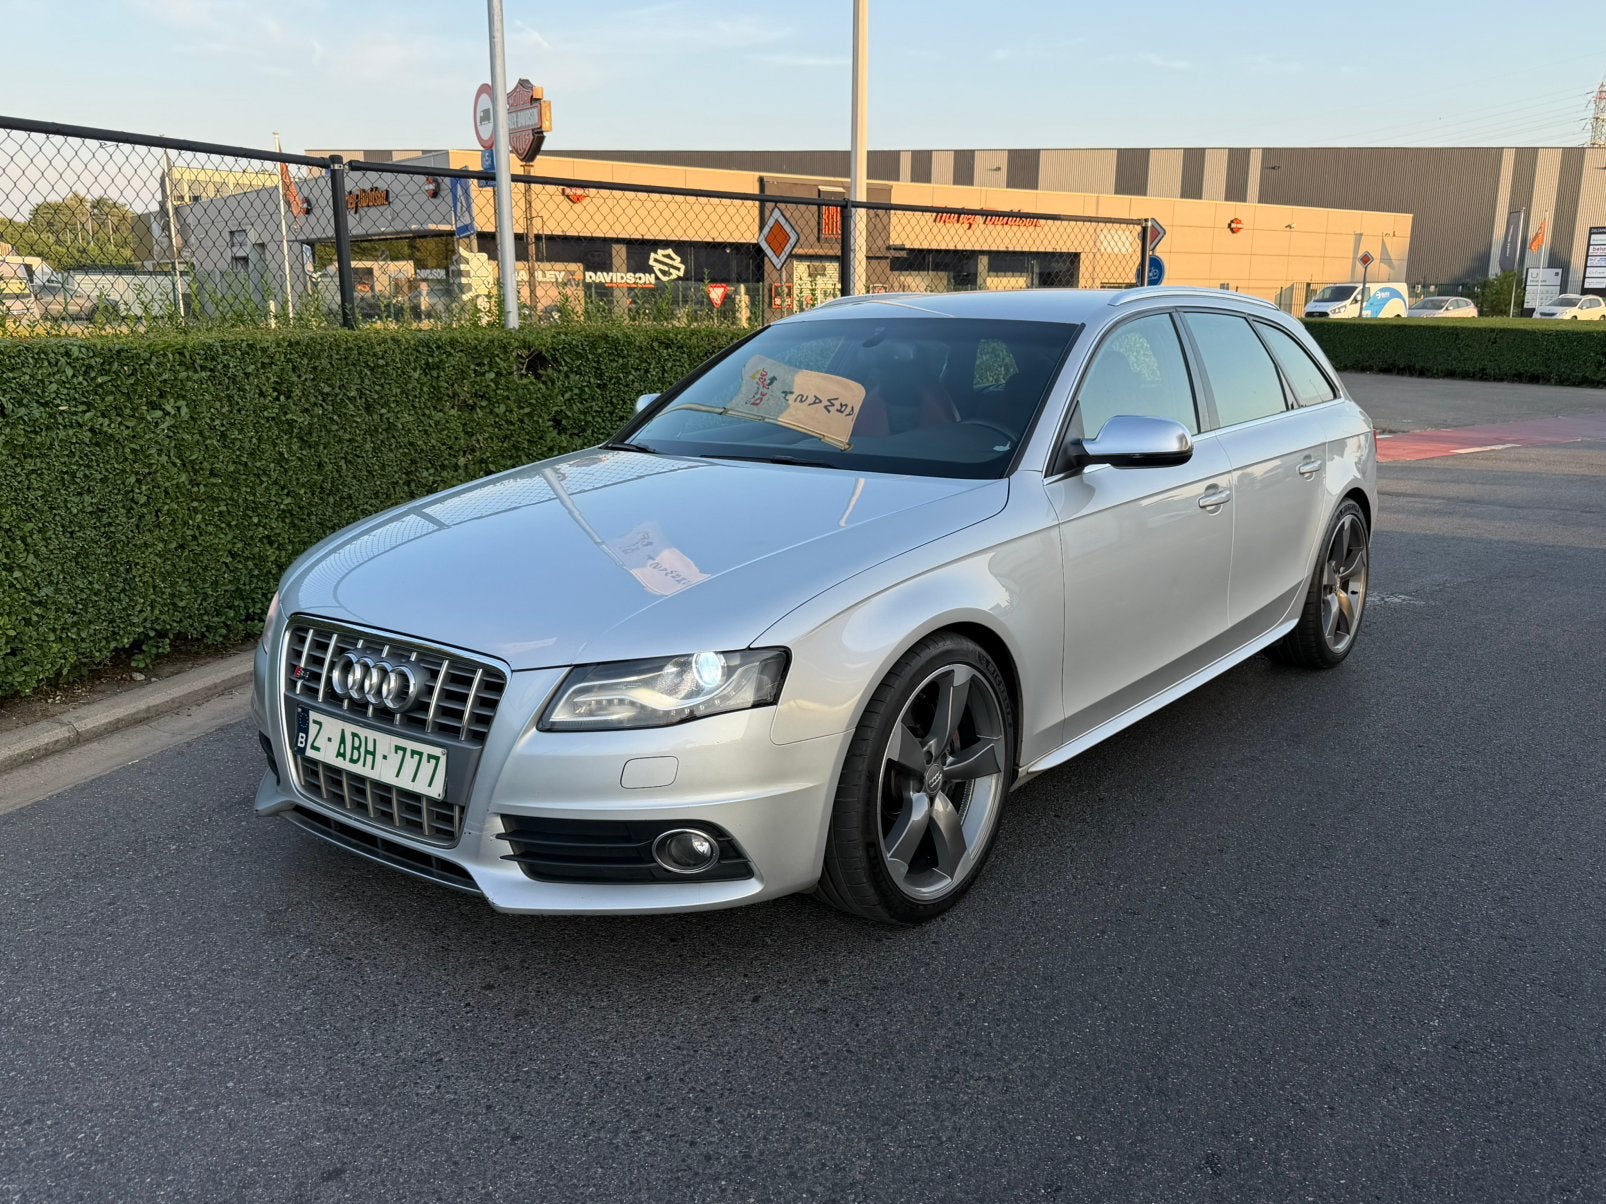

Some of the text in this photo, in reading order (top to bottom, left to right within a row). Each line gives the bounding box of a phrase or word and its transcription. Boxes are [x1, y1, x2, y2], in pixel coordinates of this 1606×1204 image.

[584, 271, 656, 285] DAVIDSON
[297, 732, 306, 748] B
[309, 718, 441, 788] Z-ABH-777
